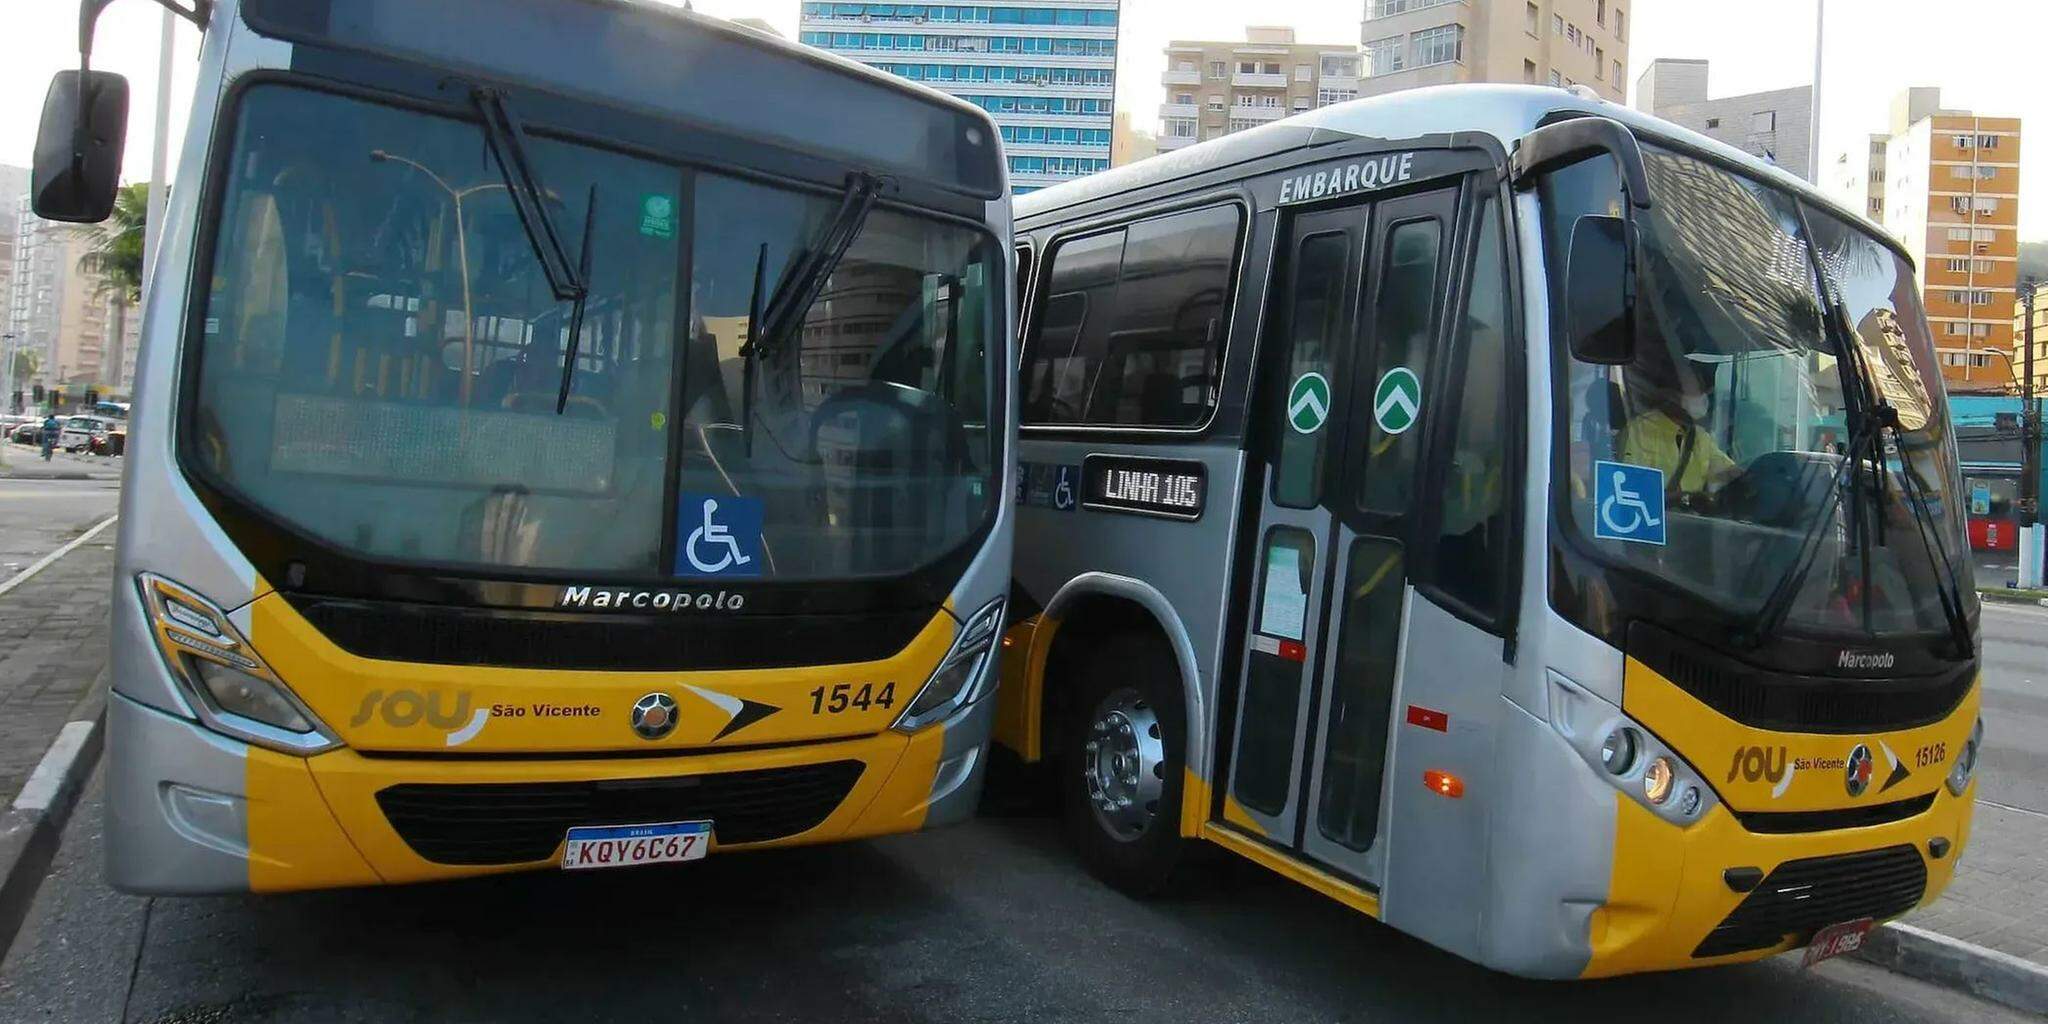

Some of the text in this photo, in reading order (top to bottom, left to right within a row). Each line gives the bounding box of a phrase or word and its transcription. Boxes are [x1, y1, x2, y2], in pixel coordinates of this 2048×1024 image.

[1279, 152, 1413, 204] EMBARQUE
[1105, 469, 1198, 507] LINHA 105
[561, 586, 745, 612] Marcopolo
[1838, 650, 1894, 669] Marcopolo
[492, 703, 526, 717] São
[533, 703, 601, 717] Vicente
[810, 682, 896, 715] 1544
[1794, 757, 1811, 770] São
[1813, 757, 1845, 770] Vicente
[1915, 742, 1946, 768] 15126
[579, 836, 697, 864] KQY6C67
